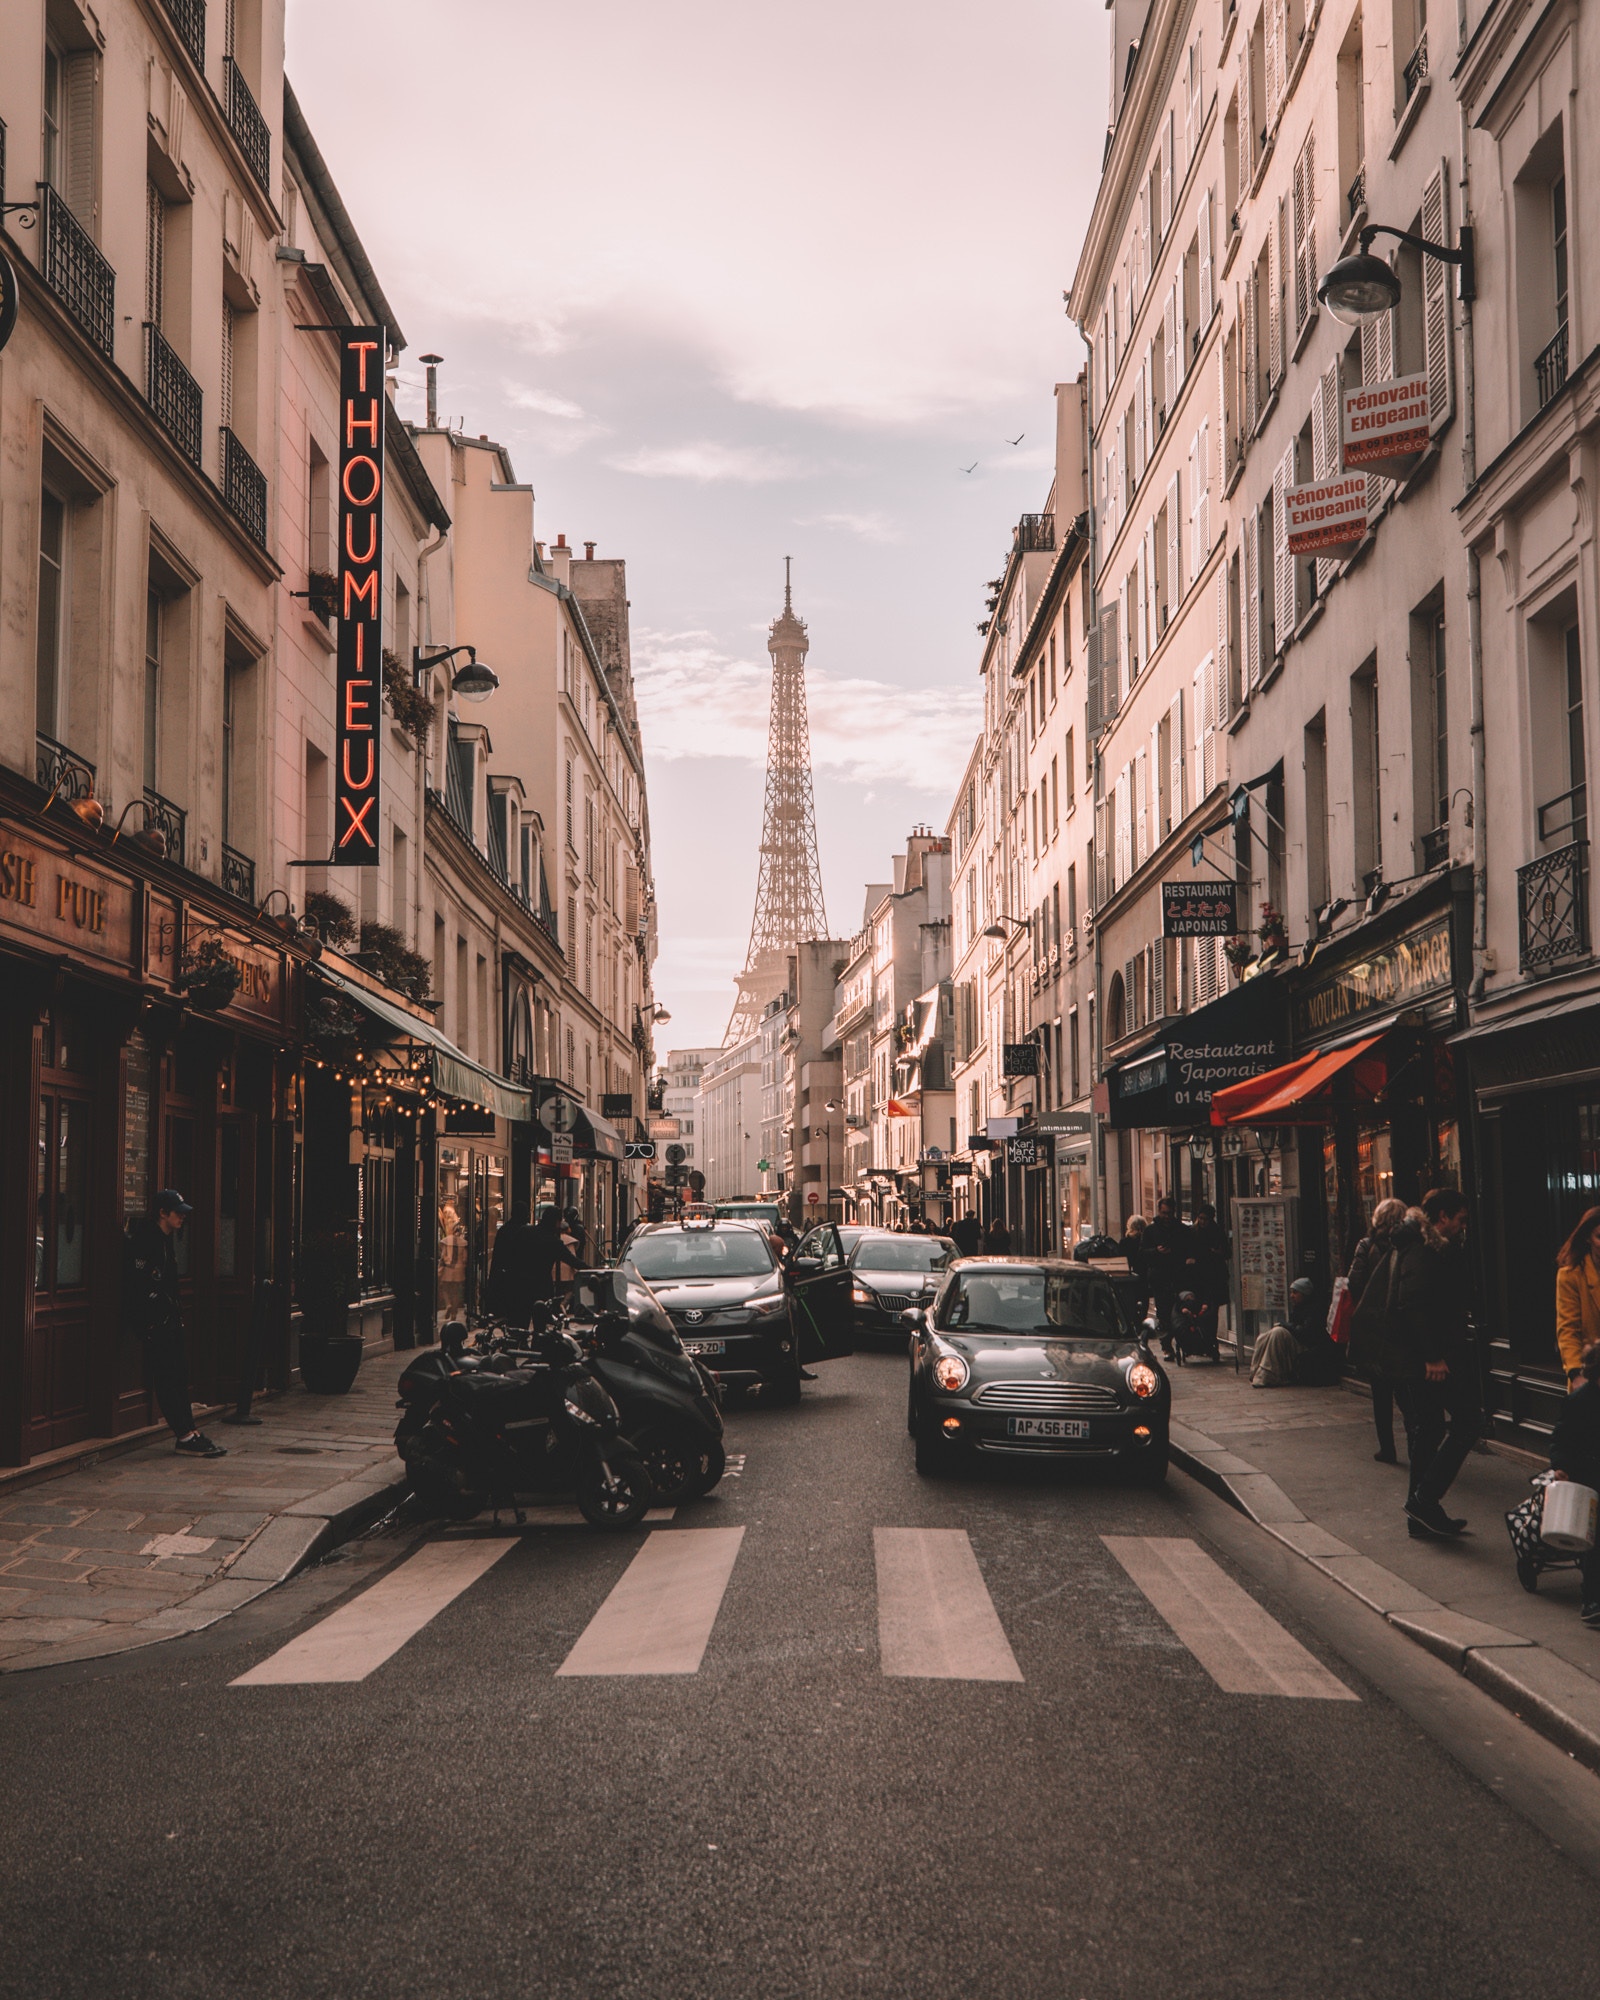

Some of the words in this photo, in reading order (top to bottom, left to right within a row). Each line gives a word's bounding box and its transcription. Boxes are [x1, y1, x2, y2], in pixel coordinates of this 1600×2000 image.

[1351, 400, 1428, 432] Exigeant
[1366, 439, 1380, 449] 09
[1383, 436, 1393, 445] 81
[1396, 432, 1410, 442] 02
[1413, 429, 1426, 438] 20
[1286, 479, 1365, 508] rénovatio
[1308, 531, 1320, 539] 09
[1323, 527, 1332, 536] 81
[1335, 524, 1347, 533] 02
[1350, 521, 1362, 529] 20
[340, 341, 380, 848] THOUMIEUX
[1164, 884, 1232, 898] RESTAURANT
[1167, 901, 1231, 918] とよたか
[1171, 920, 1228, 933] JAPONAIS
[1308, 983, 1350, 1029] MOULIN
[1010, 1047, 1034, 1057] Karl
[1168, 1040, 1275, 1060] Restaurant
[1005, 1063, 1035, 1073] John
[1180, 1061, 1266, 1085] Japonais
[1175, 1091, 1190, 1104] 01
[1195, 1090, 1212, 1104] 45
[1009, 1146, 1035, 1156] Marc
[1013, 1139, 1035, 1149] Karl
[1009, 1154, 1035, 1163] John
